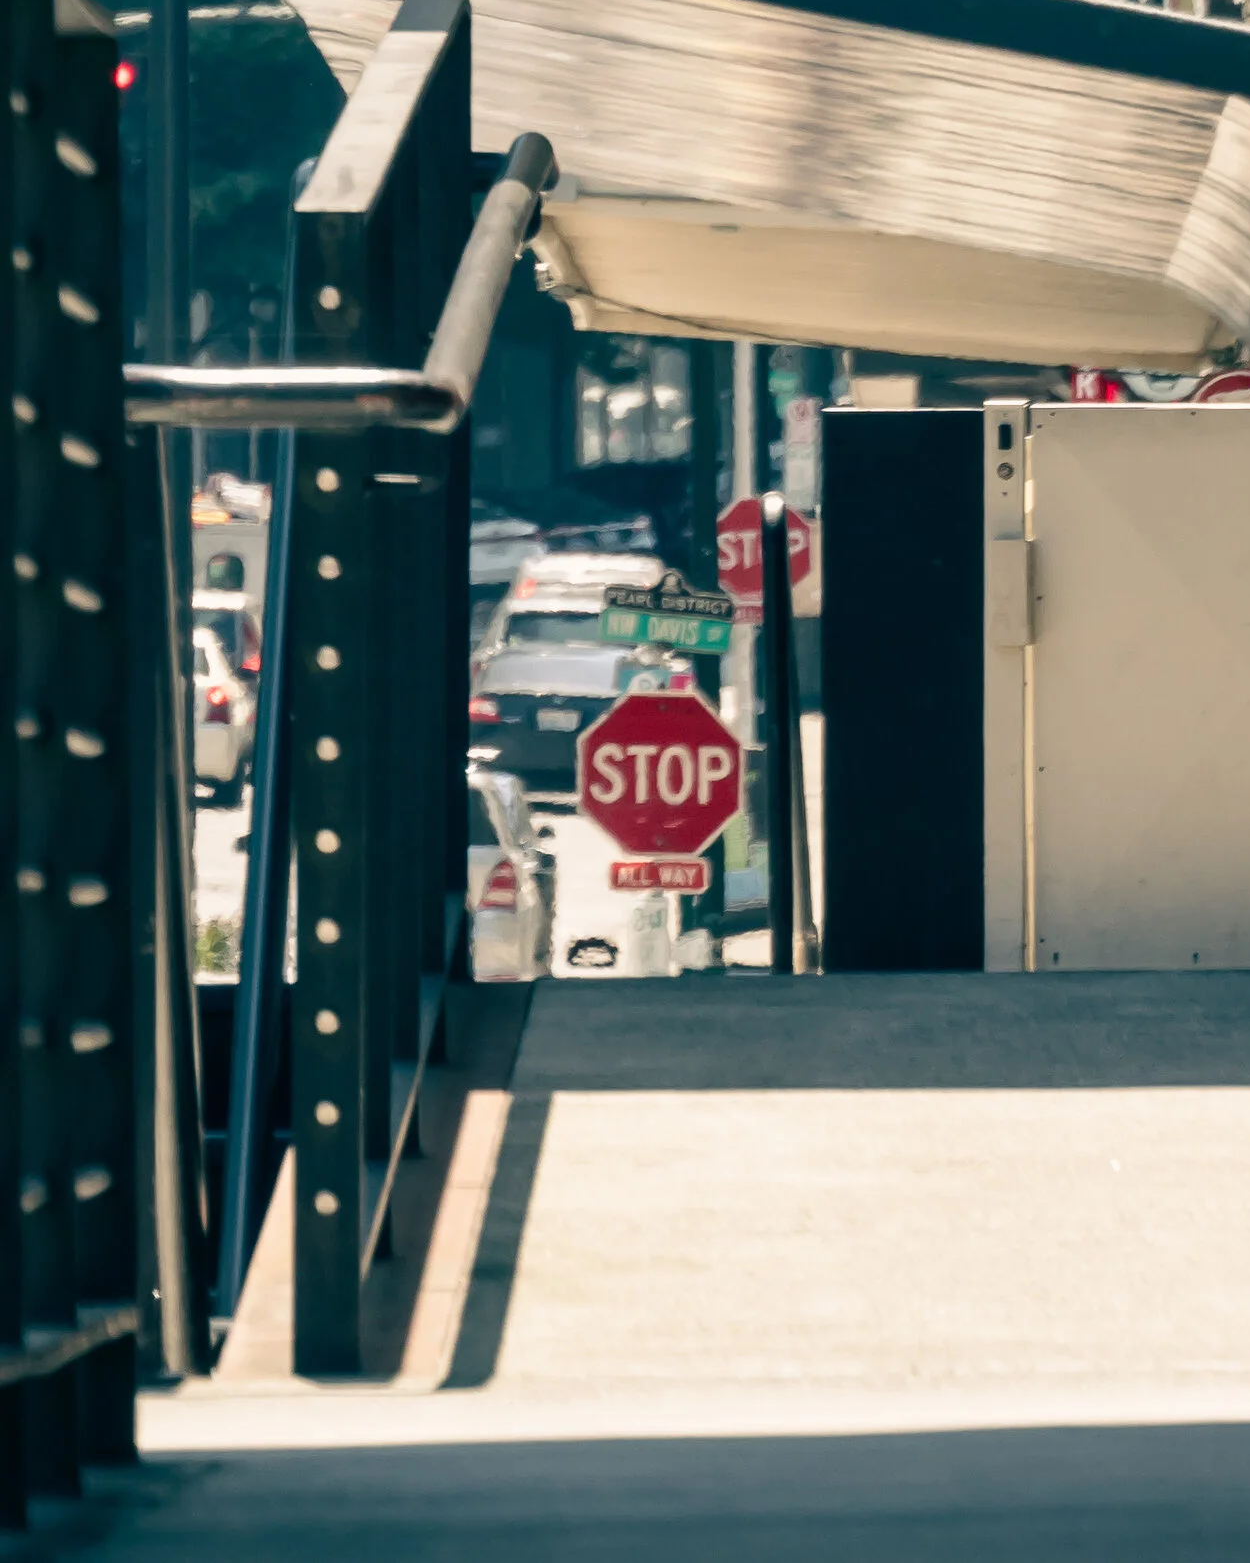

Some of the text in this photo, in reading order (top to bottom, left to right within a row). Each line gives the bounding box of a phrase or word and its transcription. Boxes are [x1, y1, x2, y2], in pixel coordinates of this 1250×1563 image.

[717, 530, 805, 571] STP
[646, 616, 700, 645] DAVIS
[589, 742, 732, 806] STOP
[617, 866, 698, 886] ALL WAY
